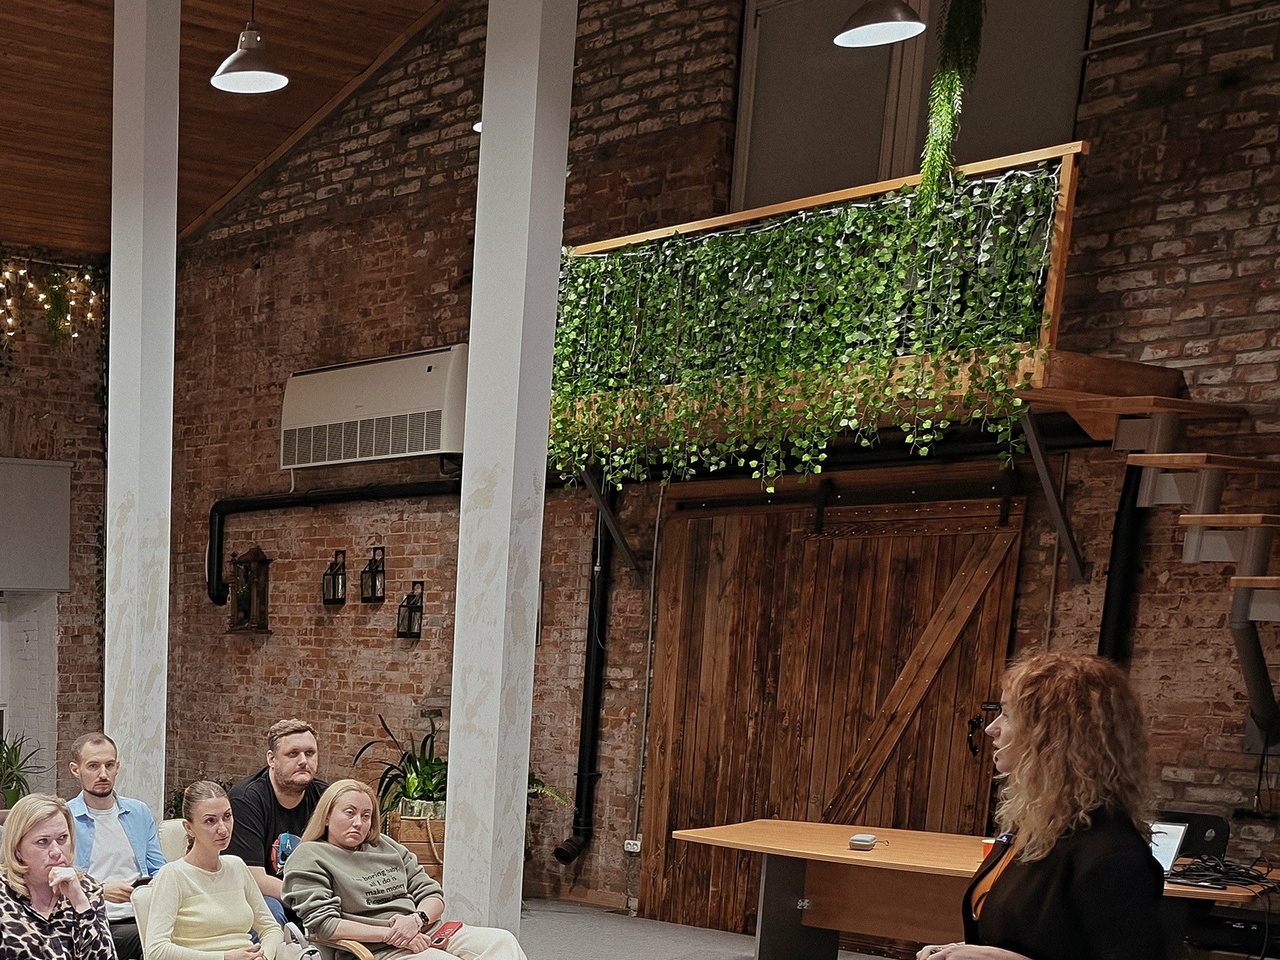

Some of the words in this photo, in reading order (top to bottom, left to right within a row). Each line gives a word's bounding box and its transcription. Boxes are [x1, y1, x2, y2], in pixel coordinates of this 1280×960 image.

[286, 839, 292, 850] A
[362, 869, 386, 881] boring
[382, 877, 391, 885] do
[365, 888, 386, 897] make
[385, 883, 405, 893] money
